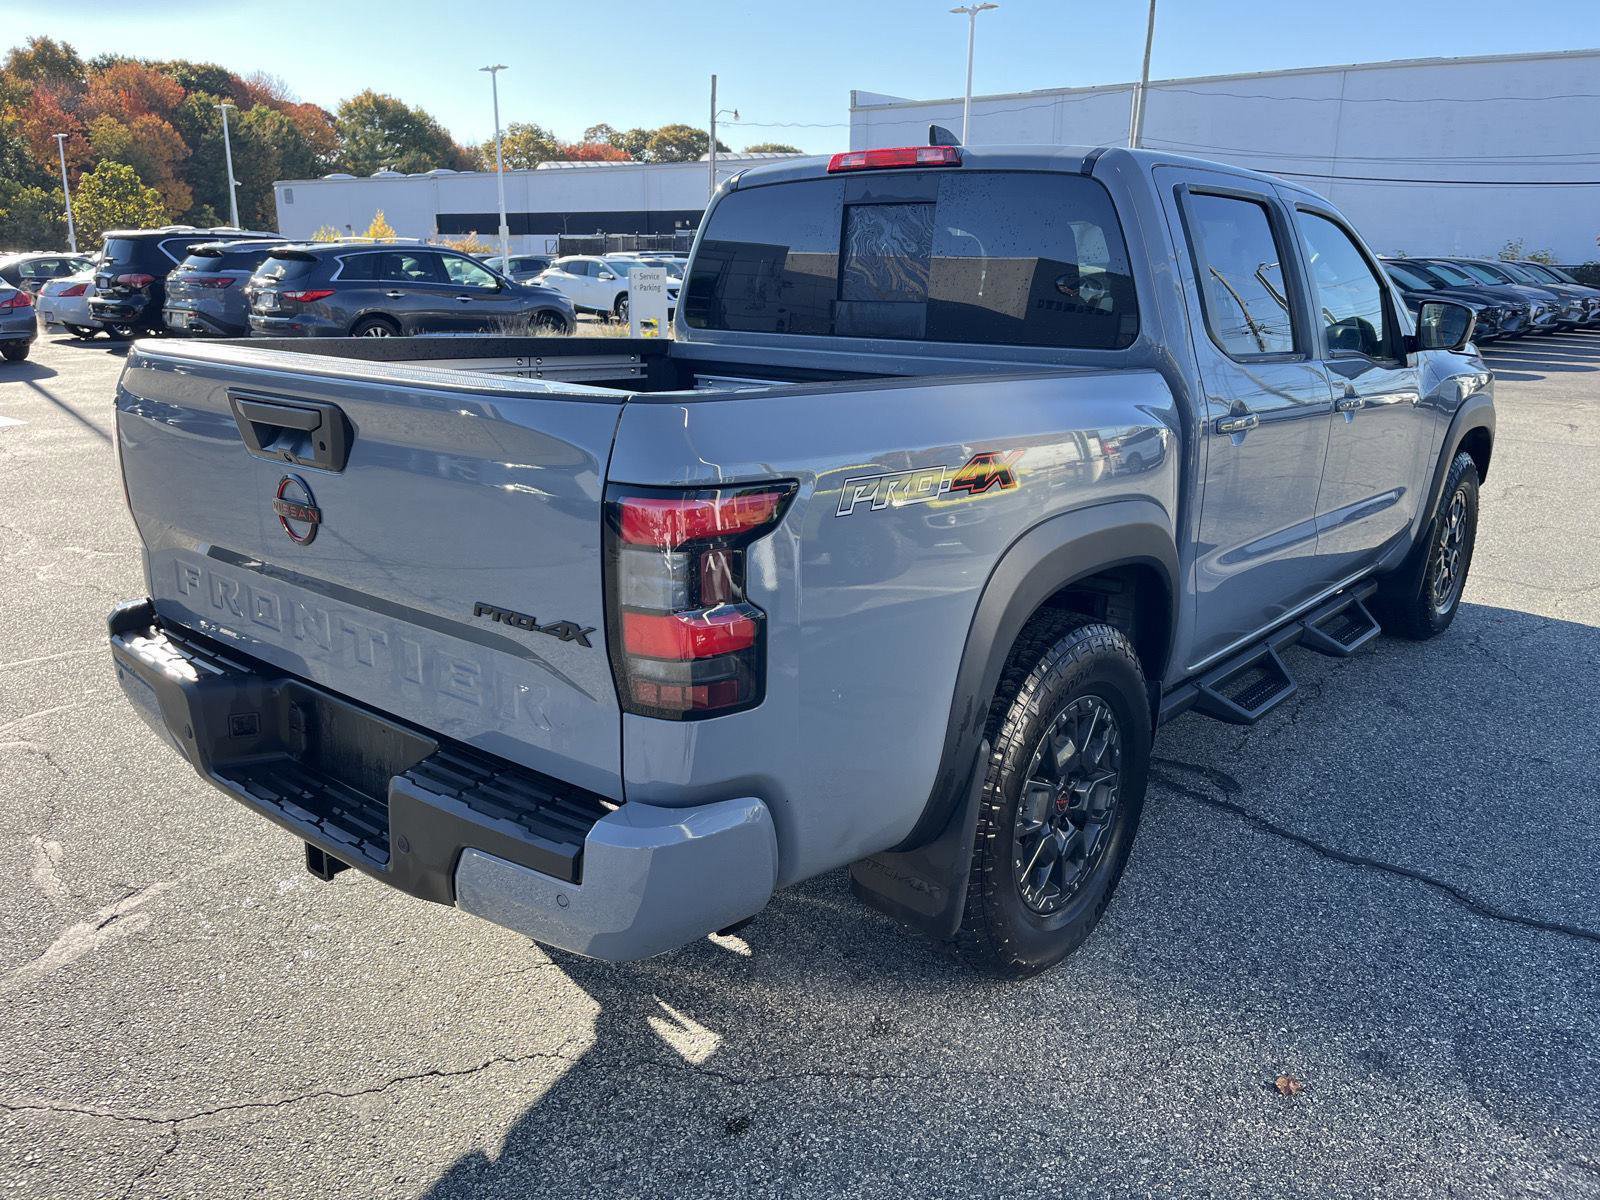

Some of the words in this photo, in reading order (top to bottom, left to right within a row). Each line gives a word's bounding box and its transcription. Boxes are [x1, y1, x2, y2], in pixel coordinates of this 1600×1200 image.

[639, 272, 660, 280] Service
[639, 283, 662, 293] Parking
[272, 501, 318, 522] NISSAN
[174, 558, 554, 732] FRONTIER
